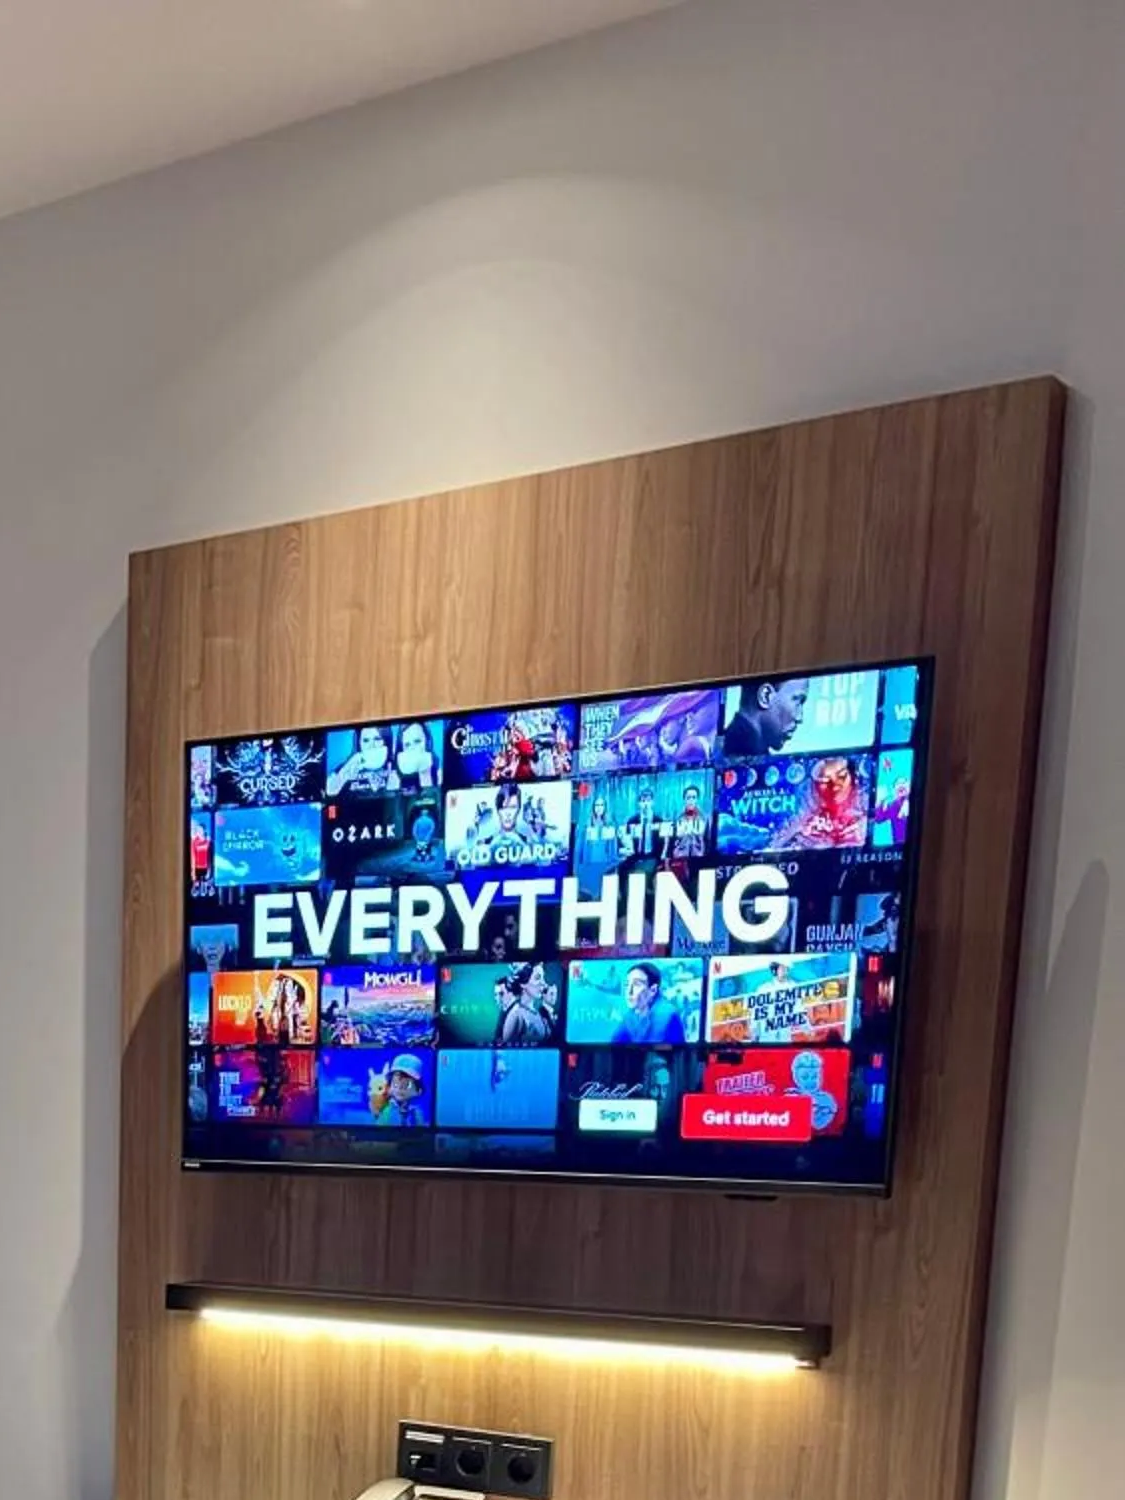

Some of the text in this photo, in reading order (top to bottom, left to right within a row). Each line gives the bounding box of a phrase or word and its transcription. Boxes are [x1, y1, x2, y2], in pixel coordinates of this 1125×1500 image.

[240, 775, 297, 796] CURSED
[731, 794, 796, 816] WITCH
[332, 824, 396, 842] OZARK
[457, 843, 557, 866] OLD GUARD
[253, 864, 790, 959] EVERYTHING
[364, 970, 422, 989] MOWGLI
[748, 982, 822, 1008] DOLEMITE
[755, 1001, 795, 1020] IS MY
[765, 1011, 808, 1031] NAME
[599, 1109, 636, 1122] Sign in
[703, 1109, 790, 1126] Get started
